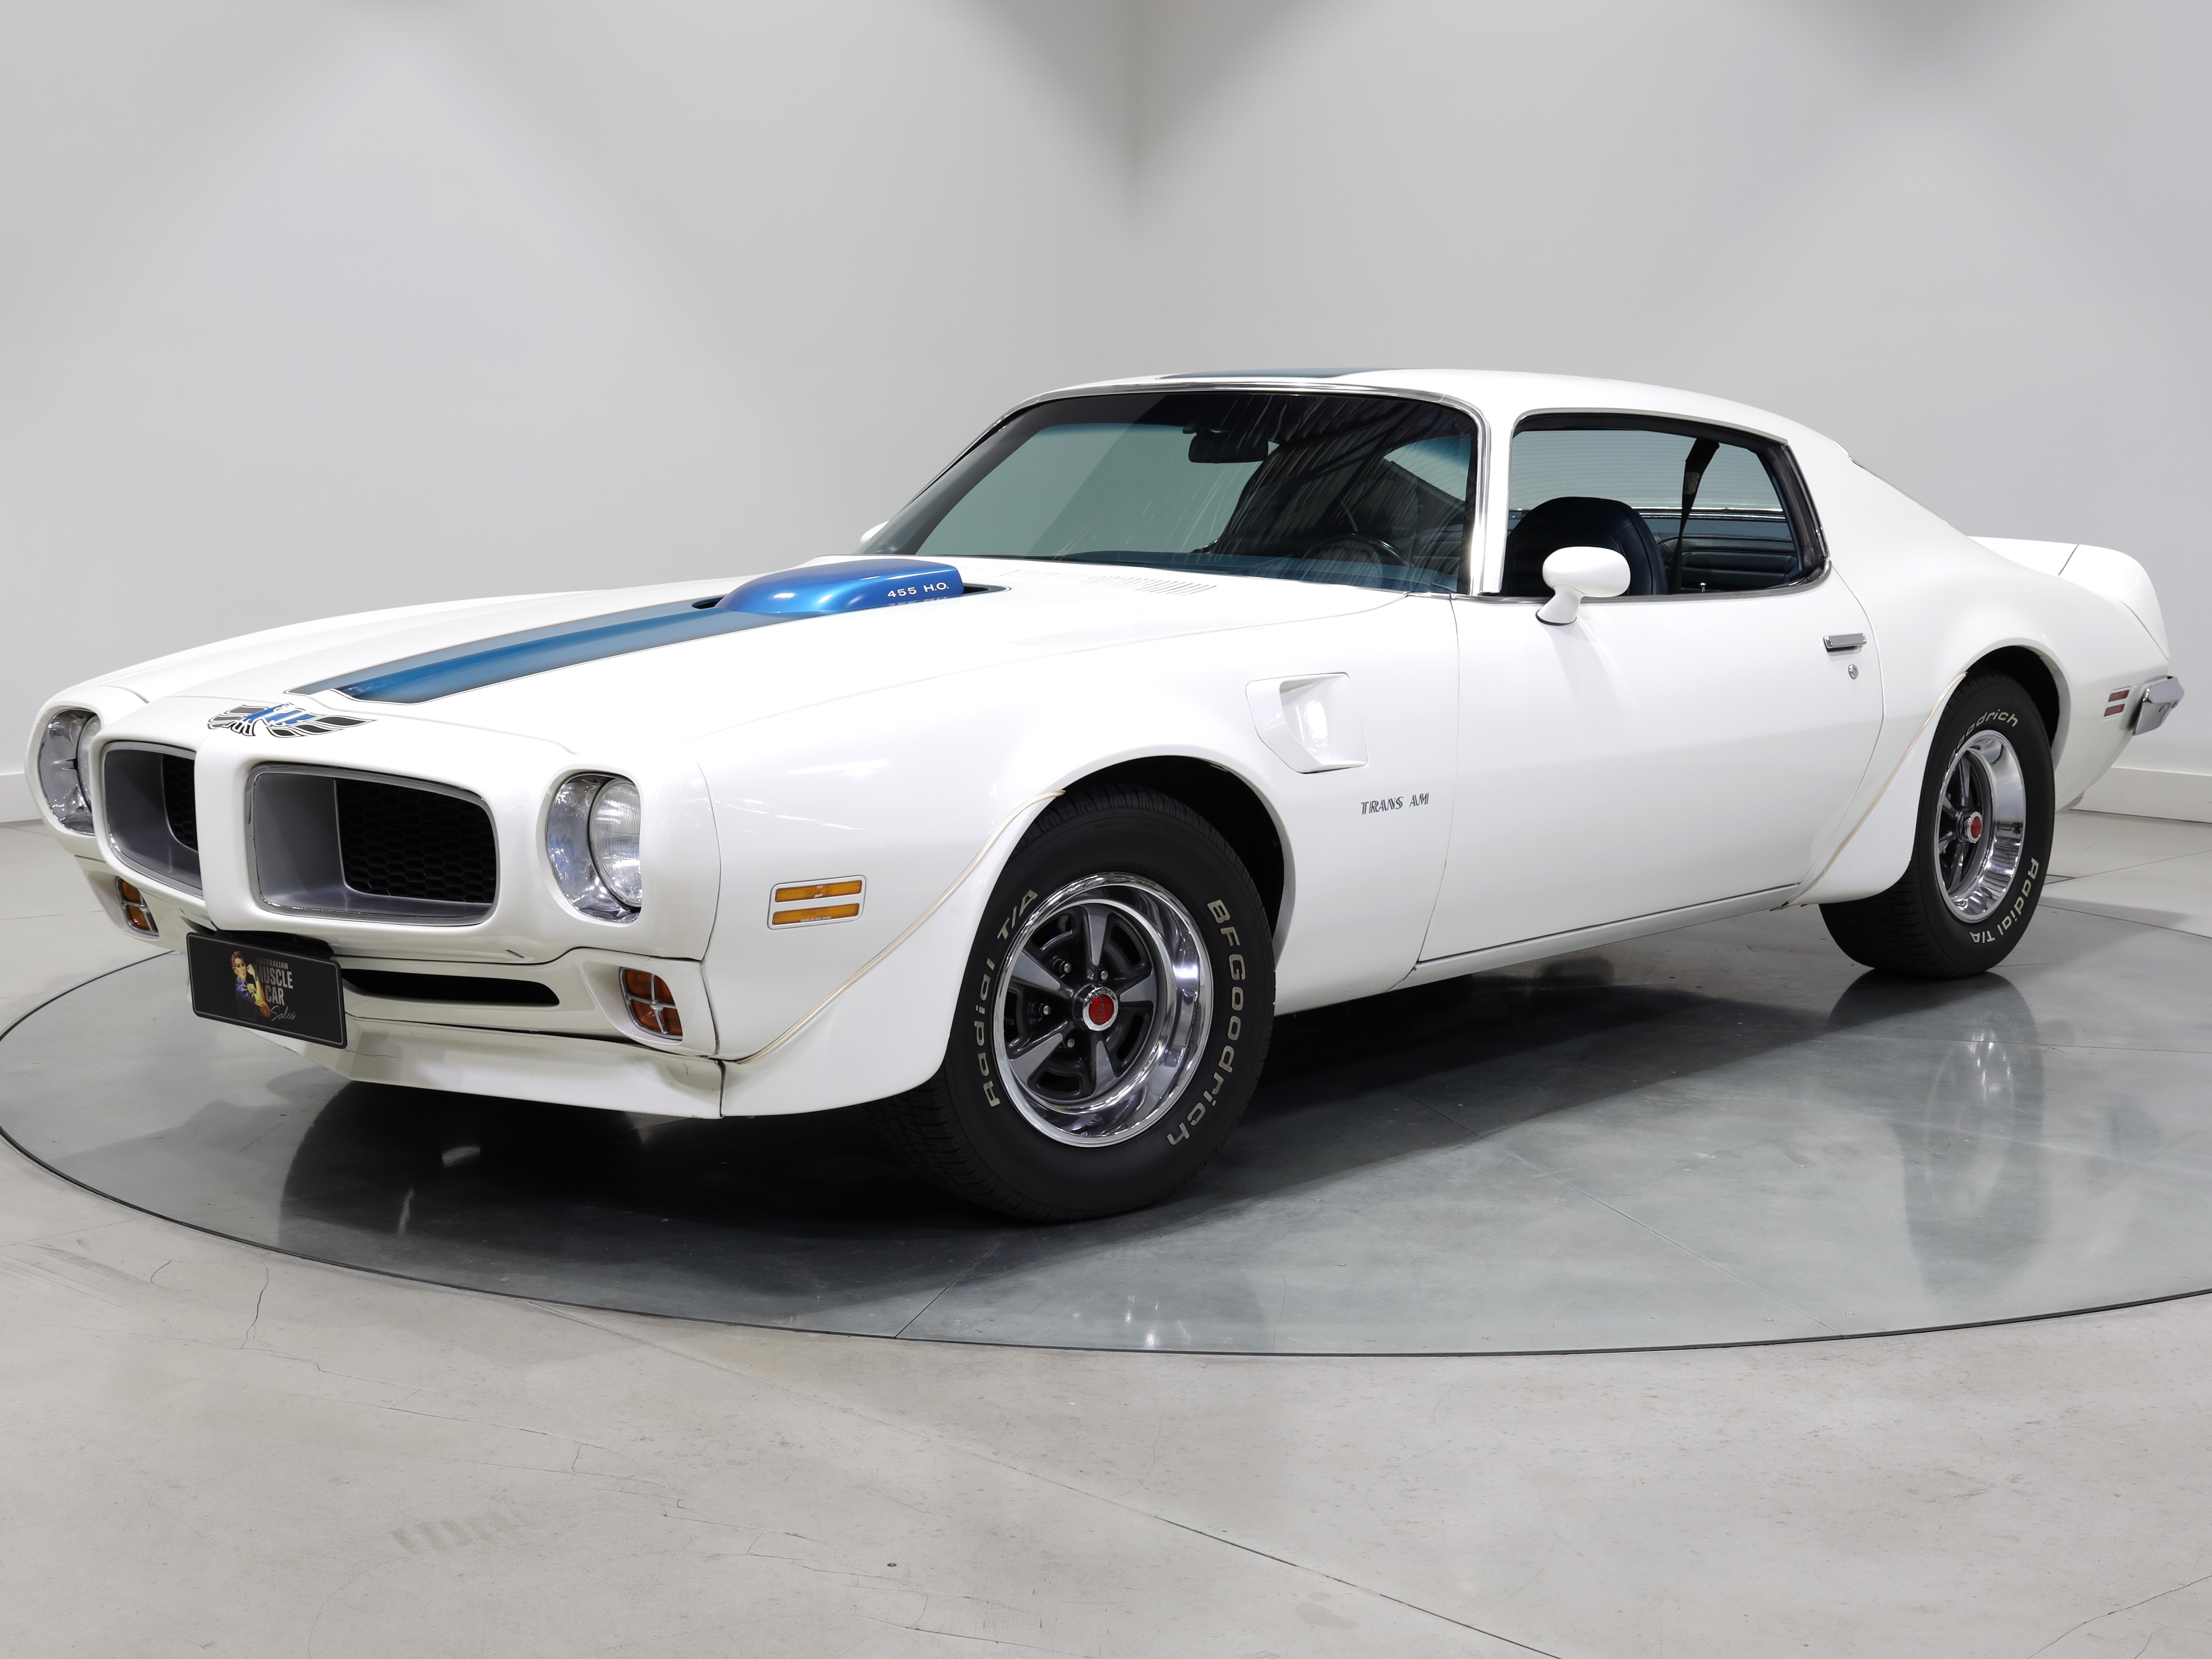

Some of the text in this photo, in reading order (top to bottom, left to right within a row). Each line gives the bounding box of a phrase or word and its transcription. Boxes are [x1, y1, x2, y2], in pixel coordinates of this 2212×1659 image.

[887, 582, 950, 598] 455 H.O.
[1360, 792, 1429, 815] TRANS AM
[1969, 857, 2039, 944] Radial T/A
[255, 957, 288, 970] AUSTRALIAN
[254, 964, 293, 989] MUSCLE
[265, 984, 285, 1006] CAR
[974, 889, 1038, 1107] Radial T/A
[271, 1005, 297, 1021] Sales
[1167, 899, 1246, 1145] BFGoodrich
